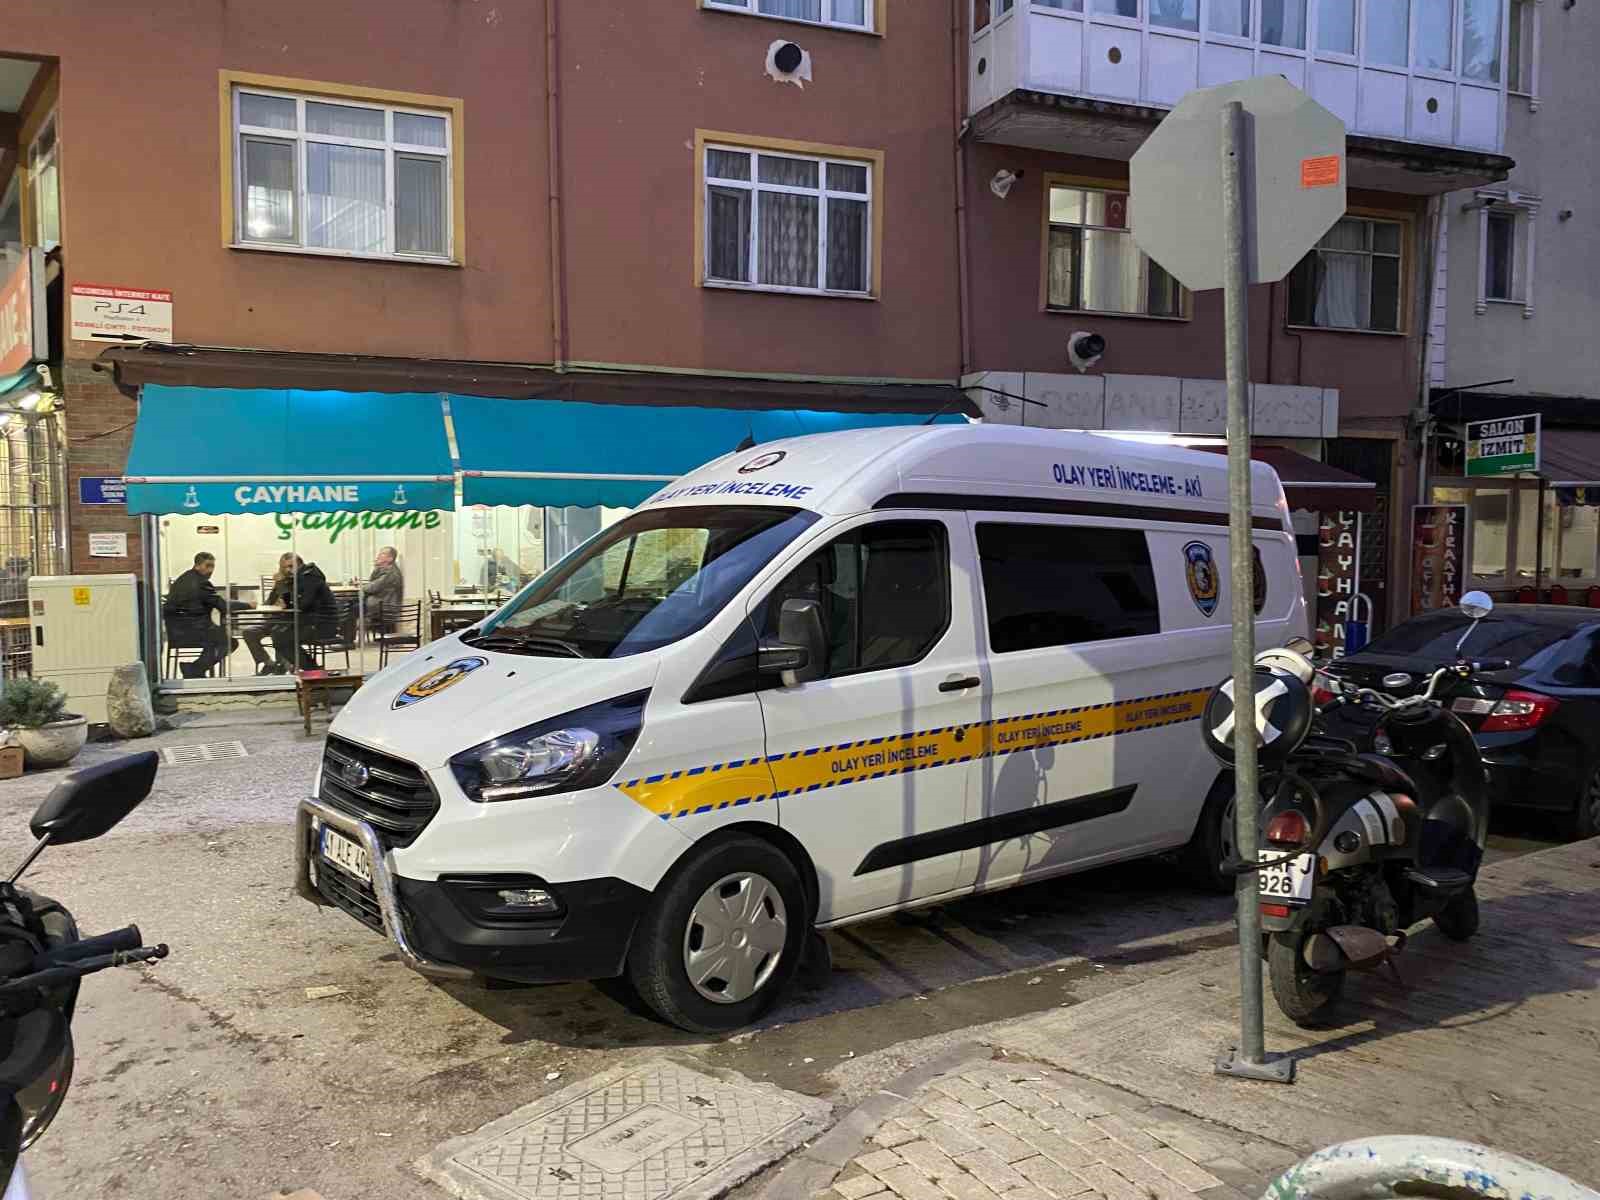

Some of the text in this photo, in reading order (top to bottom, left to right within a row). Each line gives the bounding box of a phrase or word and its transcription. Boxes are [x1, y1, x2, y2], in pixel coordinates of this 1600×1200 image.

[94, 301, 146, 315] PS4
[1480, 419, 1525, 438] SALON
[719, 479, 814, 500] İNCELEME
[1052, 463, 1085, 486] OLAY
[1087, 464, 1117, 489] YERİ
[1117, 465, 1176, 495] İNCELEME
[1185, 475, 1203, 497] AKİ
[234, 485, 360, 506] ÇAYHANE
[998, 720, 1082, 744] OLAY YERİ İNCELEME
[832, 743, 939, 773] OLAY YERİ İNCELEME
[1258, 874, 1293, 894] 926
